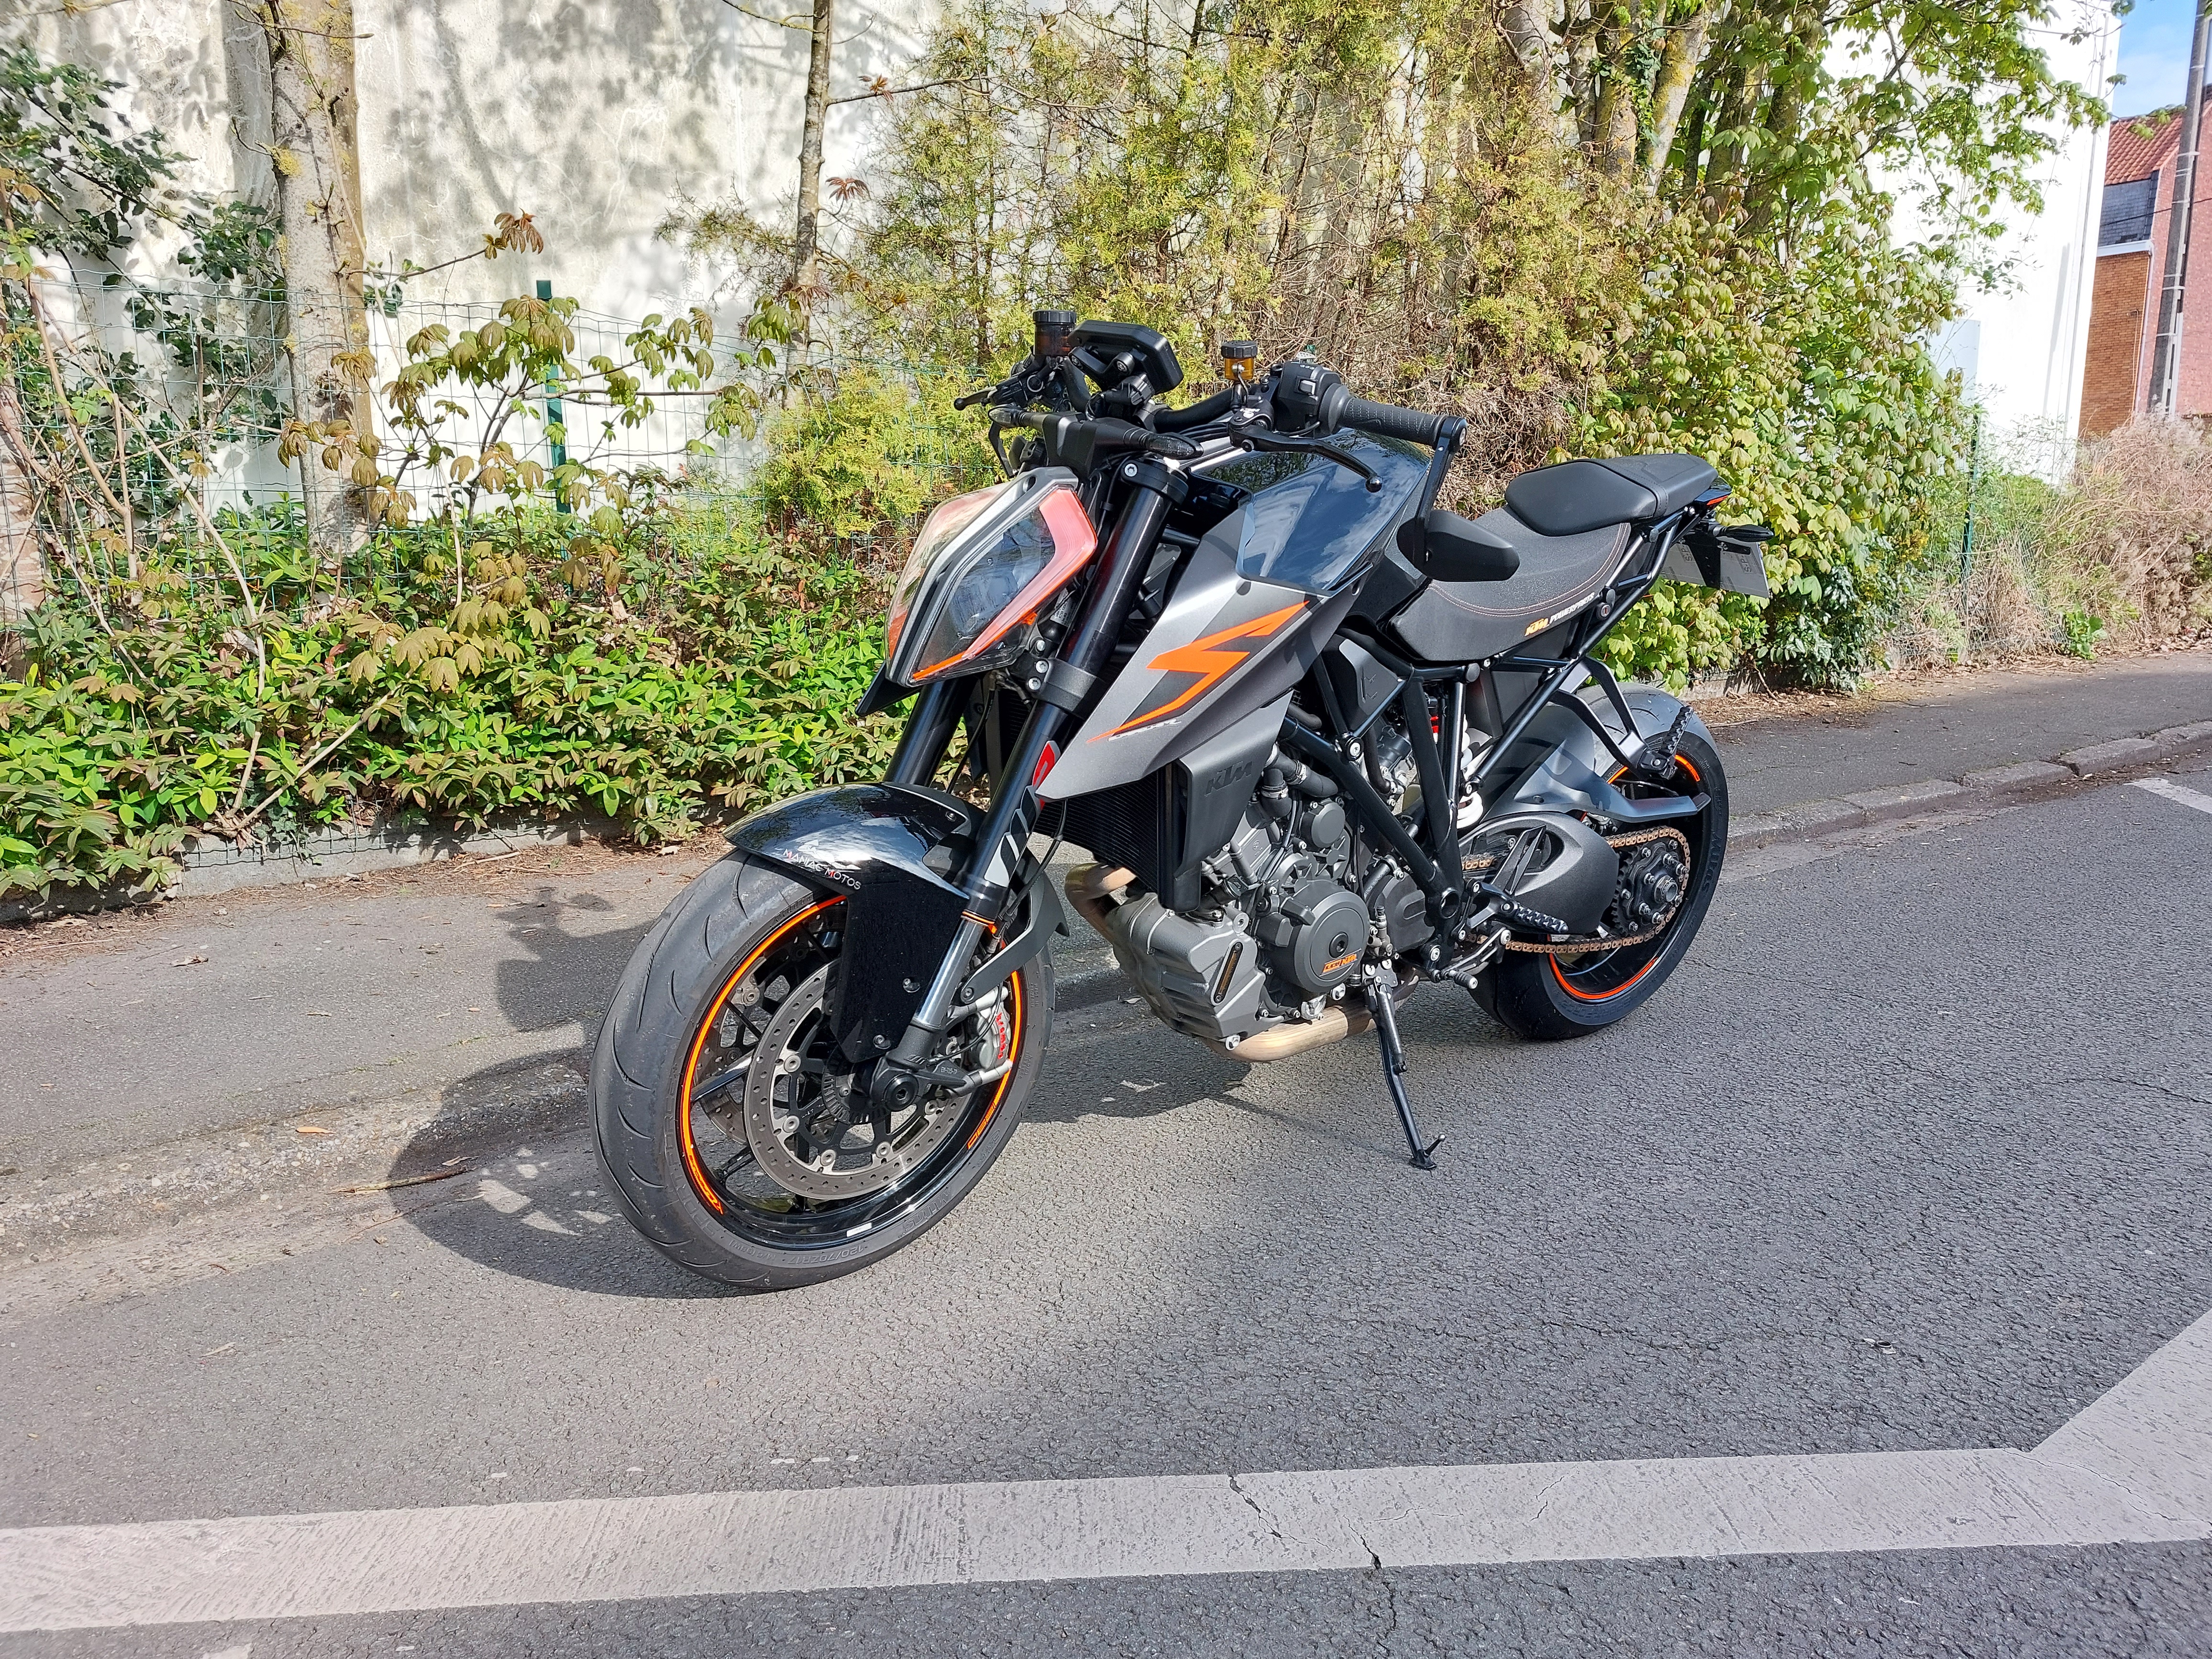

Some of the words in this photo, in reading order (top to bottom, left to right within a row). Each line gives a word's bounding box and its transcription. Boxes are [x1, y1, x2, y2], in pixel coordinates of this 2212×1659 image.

[1523, 618, 1548, 636] KTM
[1549, 592, 1595, 624] POWERPARTS
[1205, 761, 1252, 797] KTM
[783, 848, 821, 872] MANIAC
[824, 867, 861, 890] MOTOS
[670, 1172, 720, 1238] SPORT
[903, 1190, 951, 1231] Mitas
[787, 1245, 863, 1263] 120/70ZR17
